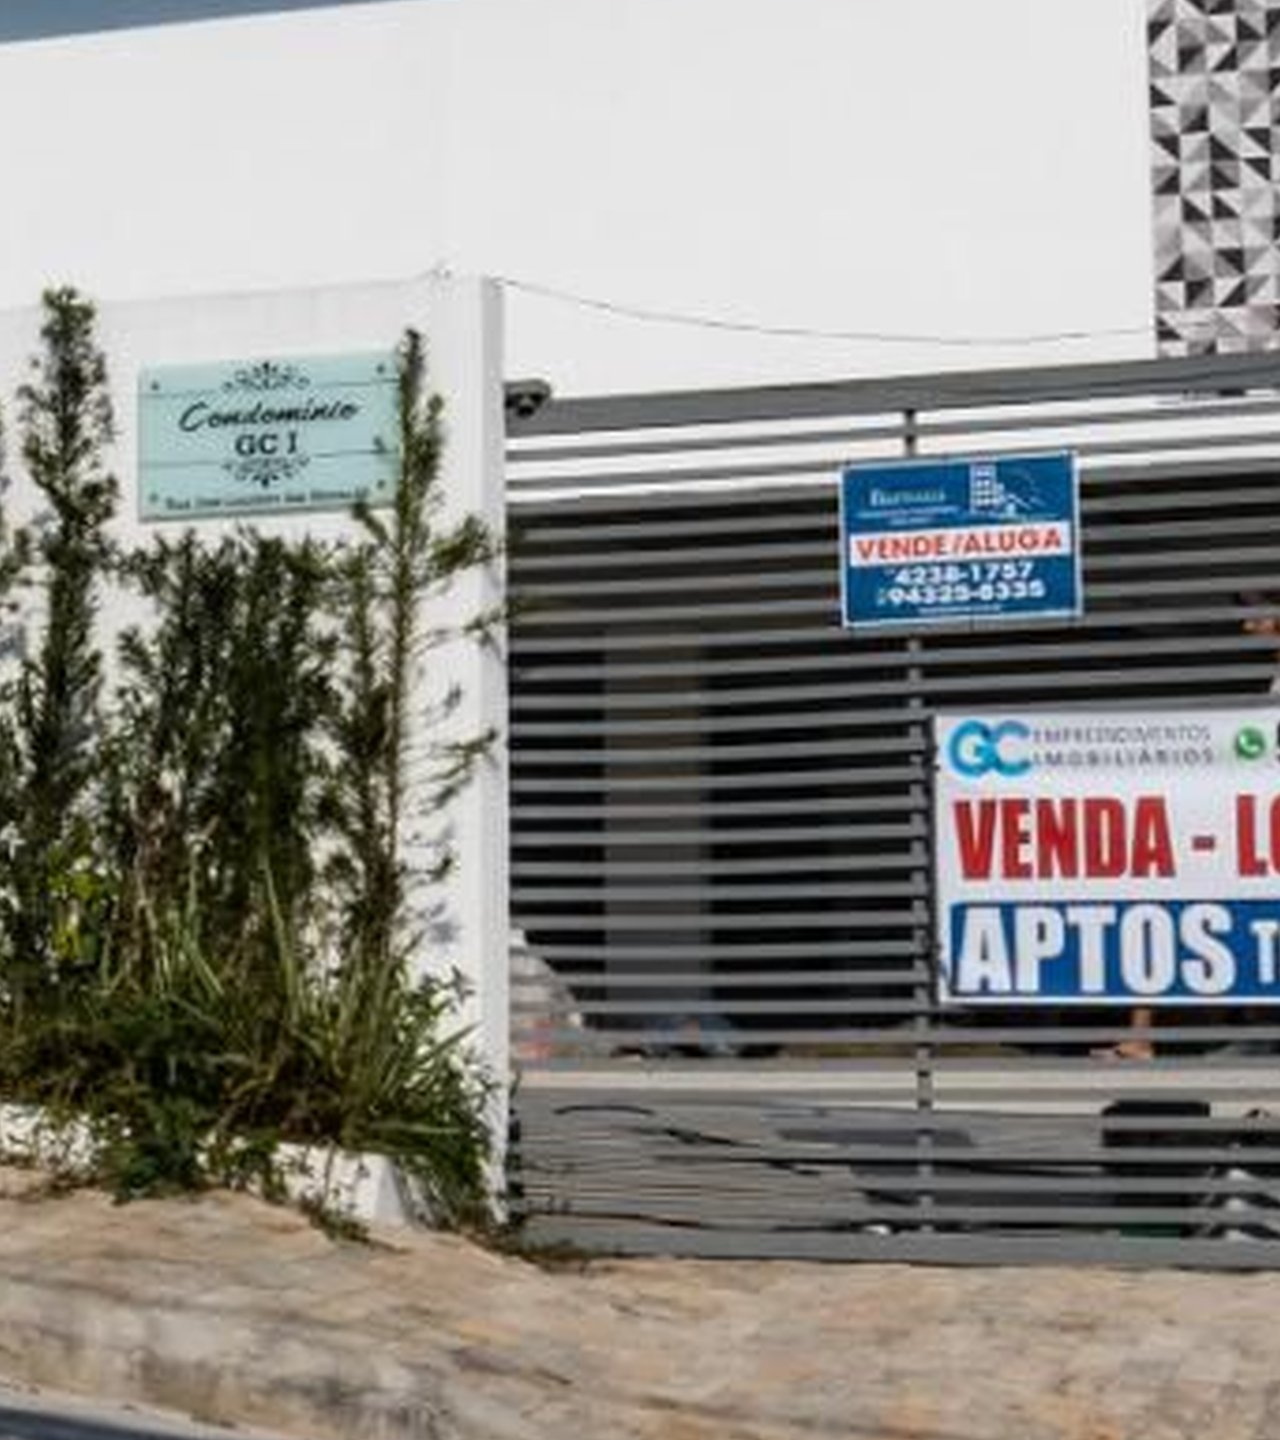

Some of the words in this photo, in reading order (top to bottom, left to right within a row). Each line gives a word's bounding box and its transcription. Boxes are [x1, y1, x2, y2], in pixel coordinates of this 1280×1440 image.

[235, 433, 279, 456] GC
[856, 528, 1062, 559] VENDE/ALUGA
[949, 720, 1032, 776] GC
[1032, 725, 1211, 745] EMPREENDIMENTOS
[954, 794, 1177, 880] VENDA
[956, 903, 1236, 995] APTOS
